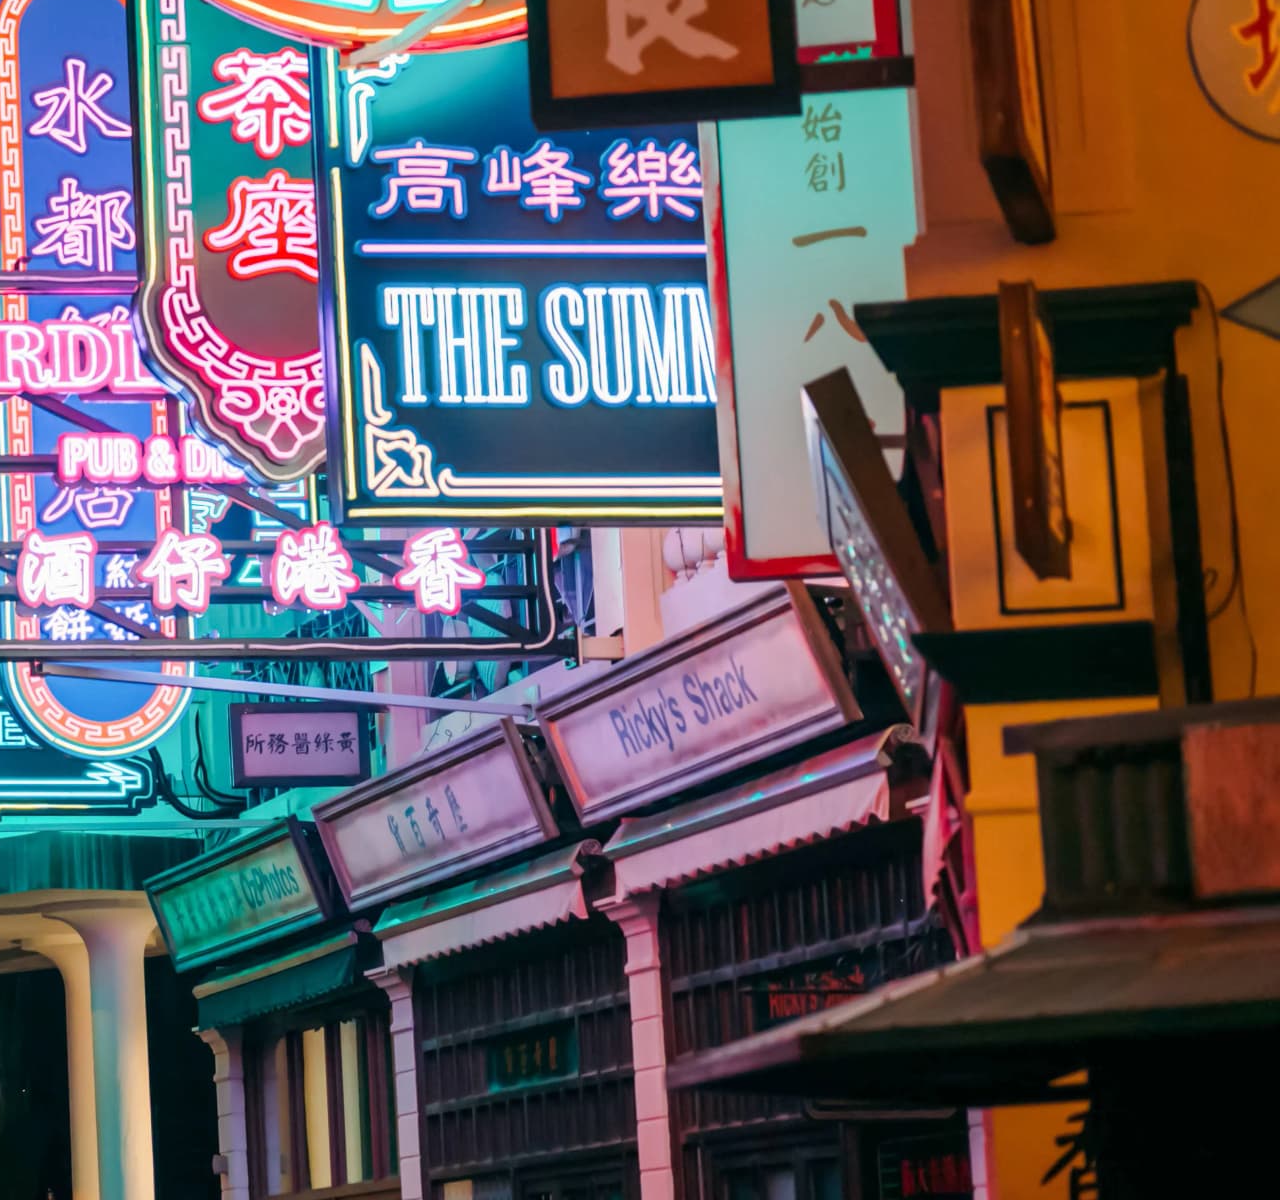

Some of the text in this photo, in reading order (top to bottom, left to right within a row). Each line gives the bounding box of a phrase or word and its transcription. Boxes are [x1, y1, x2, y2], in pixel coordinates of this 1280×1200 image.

[370, 138, 704, 220] 高峰樂
[382, 286, 530, 405] THE
[60, 434, 141, 482] PUB
[144, 435, 180, 482] &
[608, 655, 759, 758] Ricky's Shack
